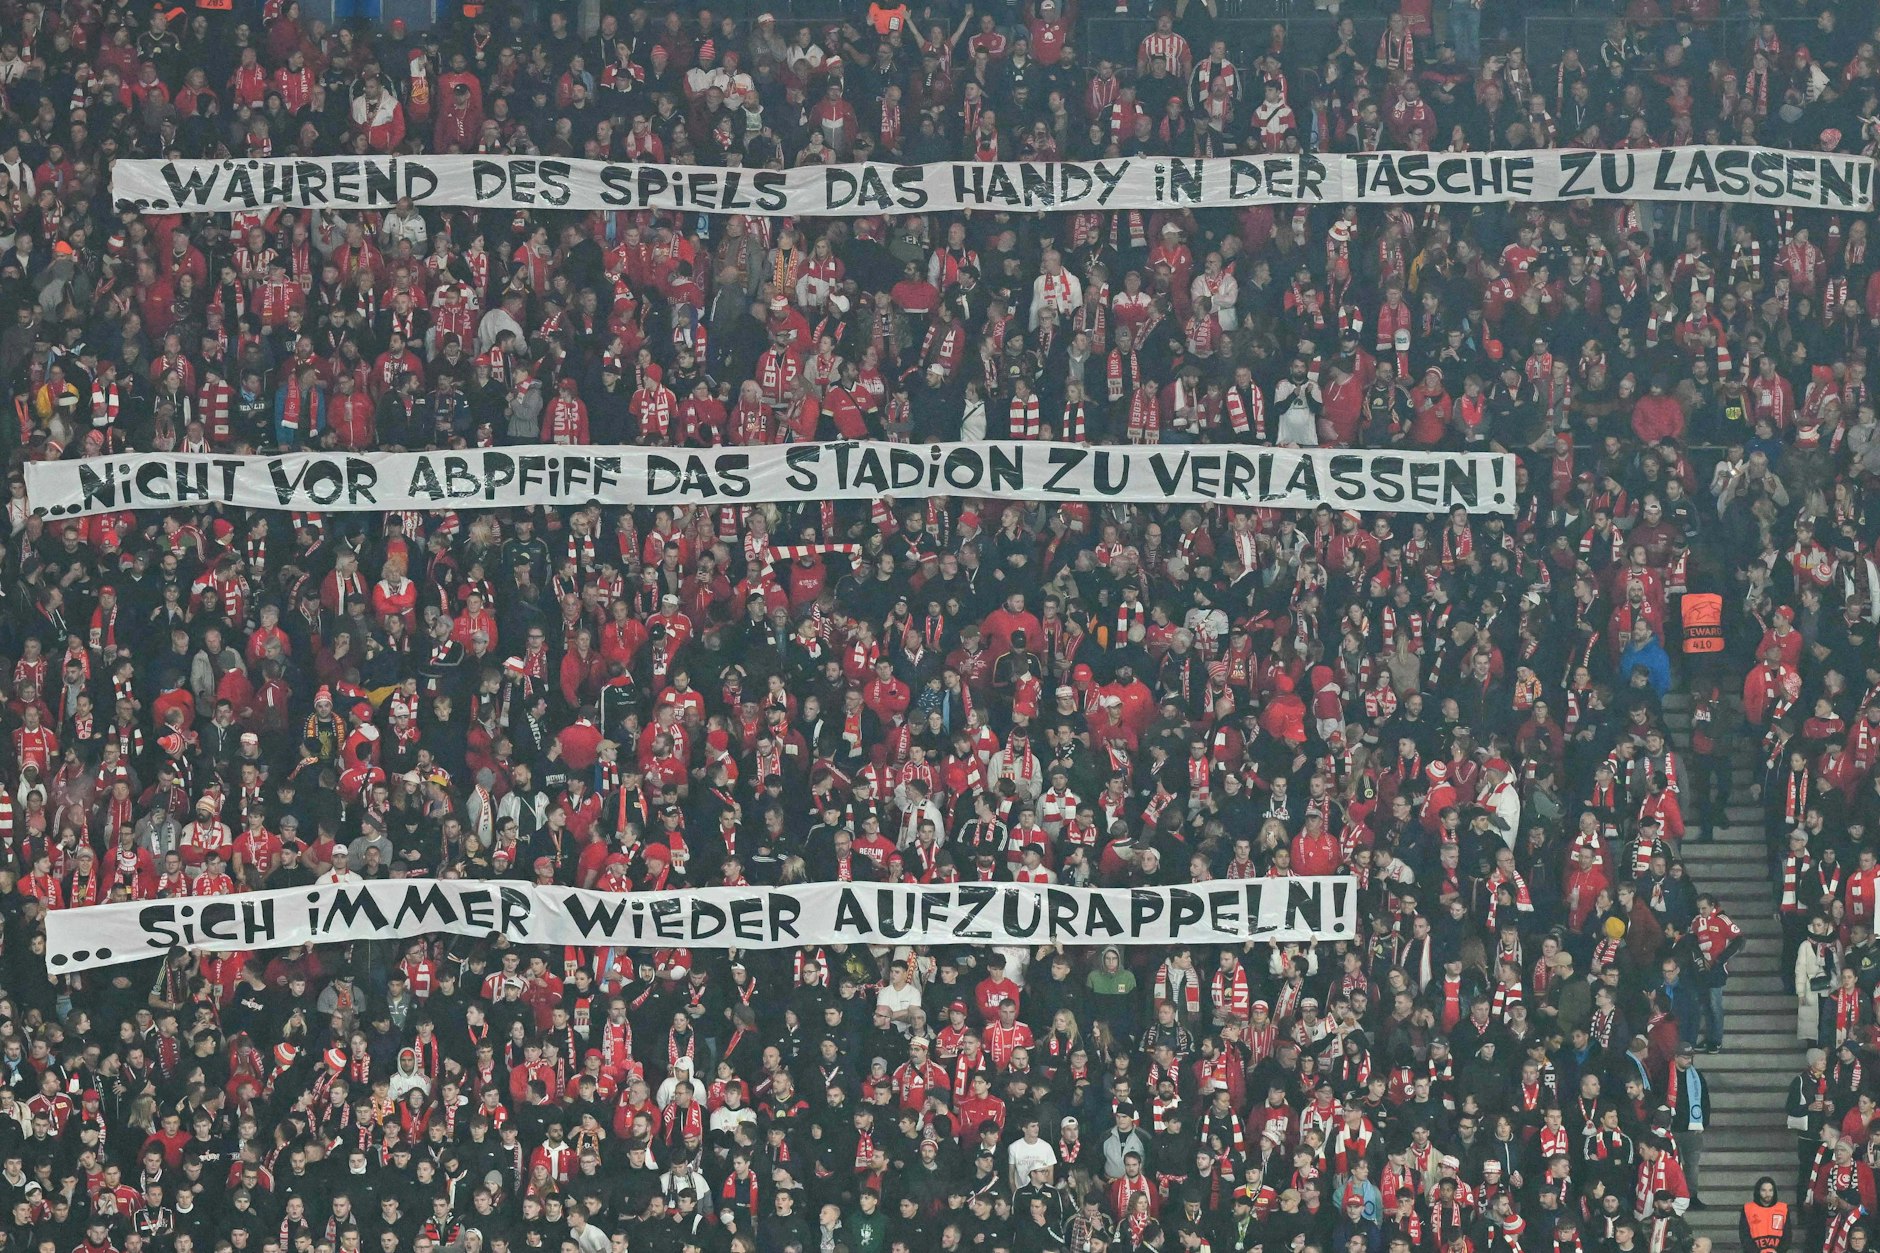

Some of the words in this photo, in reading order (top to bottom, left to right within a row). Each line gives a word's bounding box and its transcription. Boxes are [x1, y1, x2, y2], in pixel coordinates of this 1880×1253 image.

[115, 159, 438, 209] ...WÄHREND
[473, 160, 571, 206] DES
[600, 169, 787, 210] SPiELS
[826, 166, 928, 210] DAS
[952, 160, 1130, 206] HANDY
[1230, 153, 1326, 200] DER
[1346, 153, 1534, 197] TASCHE
[1558, 151, 1633, 197] ZU
[1654, 149, 1871, 207] LASSEN!
[34, 460, 245, 516] ...NiCHT
[267, 456, 378, 505] VOR
[647, 454, 750, 497] DAS
[785, 441, 1023, 493] STADiON
[1043, 447, 1130, 495] ZU
[1149, 450, 1506, 506] VERLASSEN!
[1693, 641, 1711, 649] 410
[859, 848, 883, 857] BERLIN
[139, 897, 276, 948] SiCH
[306, 882, 531, 937] iMMER
[563, 893, 801, 942] WiEDER
[834, 880, 1348, 939] AUFZURAPPELN!
